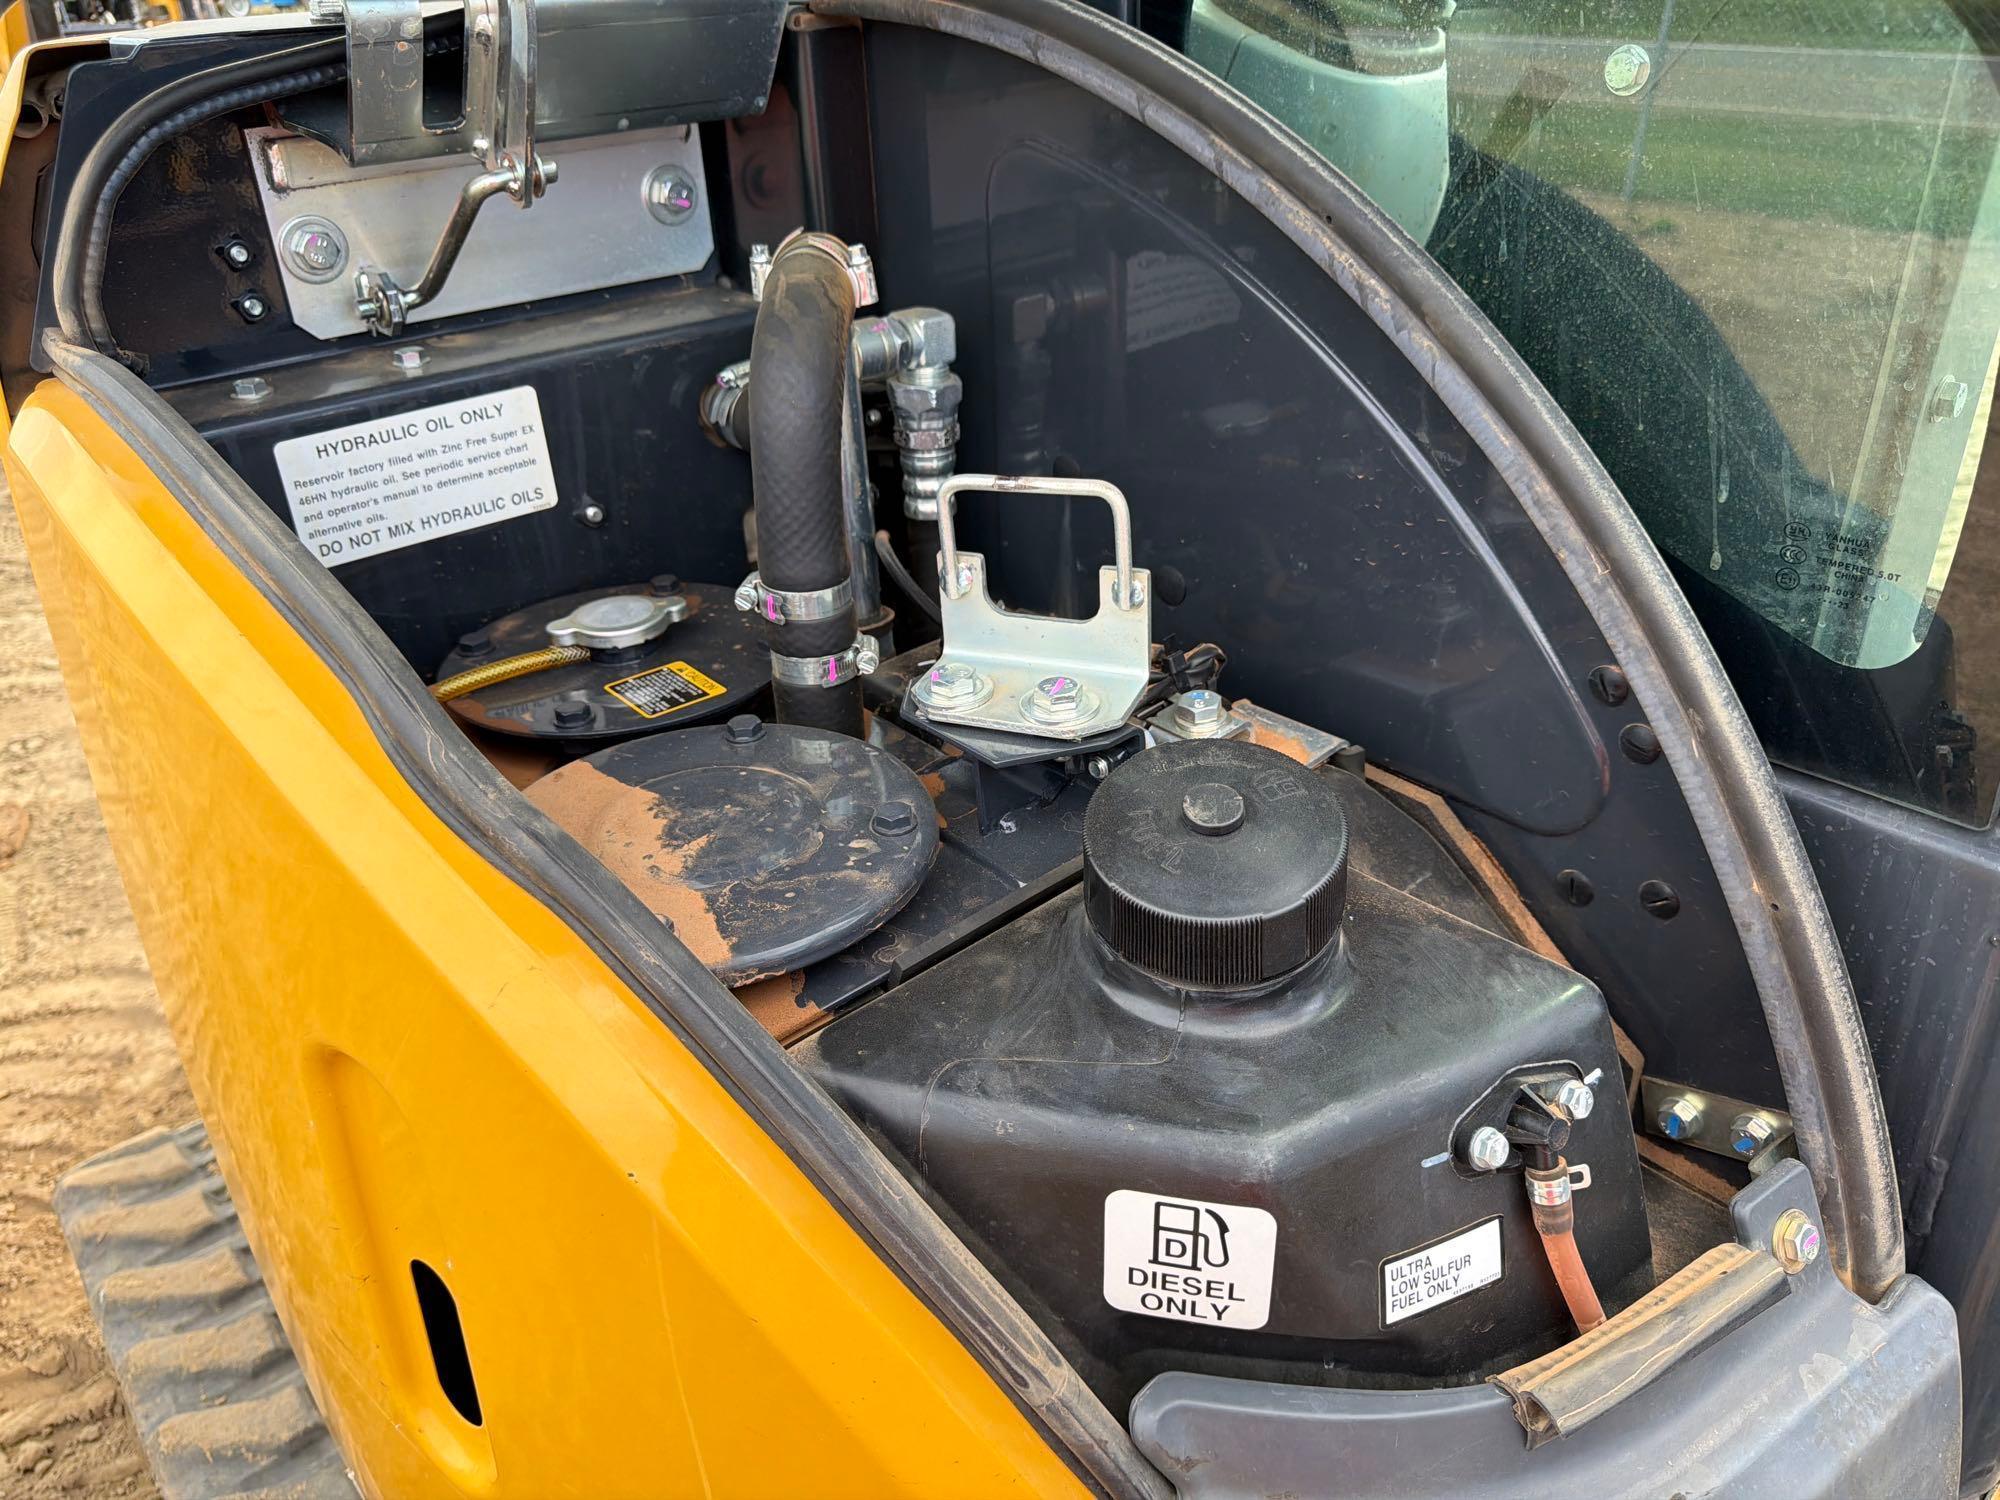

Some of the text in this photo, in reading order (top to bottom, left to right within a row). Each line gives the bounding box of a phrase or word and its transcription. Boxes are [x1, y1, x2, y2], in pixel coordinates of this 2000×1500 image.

[316, 403, 503, 459] HYDRAULIC OIL ONLY
[293, 424, 535, 490] Reservoir factory filled with Zinc Free Super EX
[299, 443, 528, 506] 46HN hydraulic oil. See periodic service chart
[303, 457, 537, 524] and operator's manual to determine acceptable
[308, 513, 389, 540] alternative oils.
[318, 540, 343, 557] DO
[348, 529, 381, 549] NOT
[388, 520, 416, 539] MIX
[420, 496, 506, 531] HYDRAULIC
[511, 486, 544, 506] OILS
[1825, 532, 1871, 549] YANHUA
[1828, 543, 1864, 557] GLASS
[1816, 556, 1902, 583] TEMPERED 5.0T
[1834, 571, 1865, 584] CHINA
[1128, 1266, 1245, 1302] DIESEL
[1390, 1255, 1432, 1281] ULTRA
[1391, 1254, 1471, 1298] LOW SULFUR
[1140, 1292, 1230, 1321] ONLY
[1391, 1290, 1424, 1313] FUEL
[1427, 1274, 1461, 1298] ONLY
